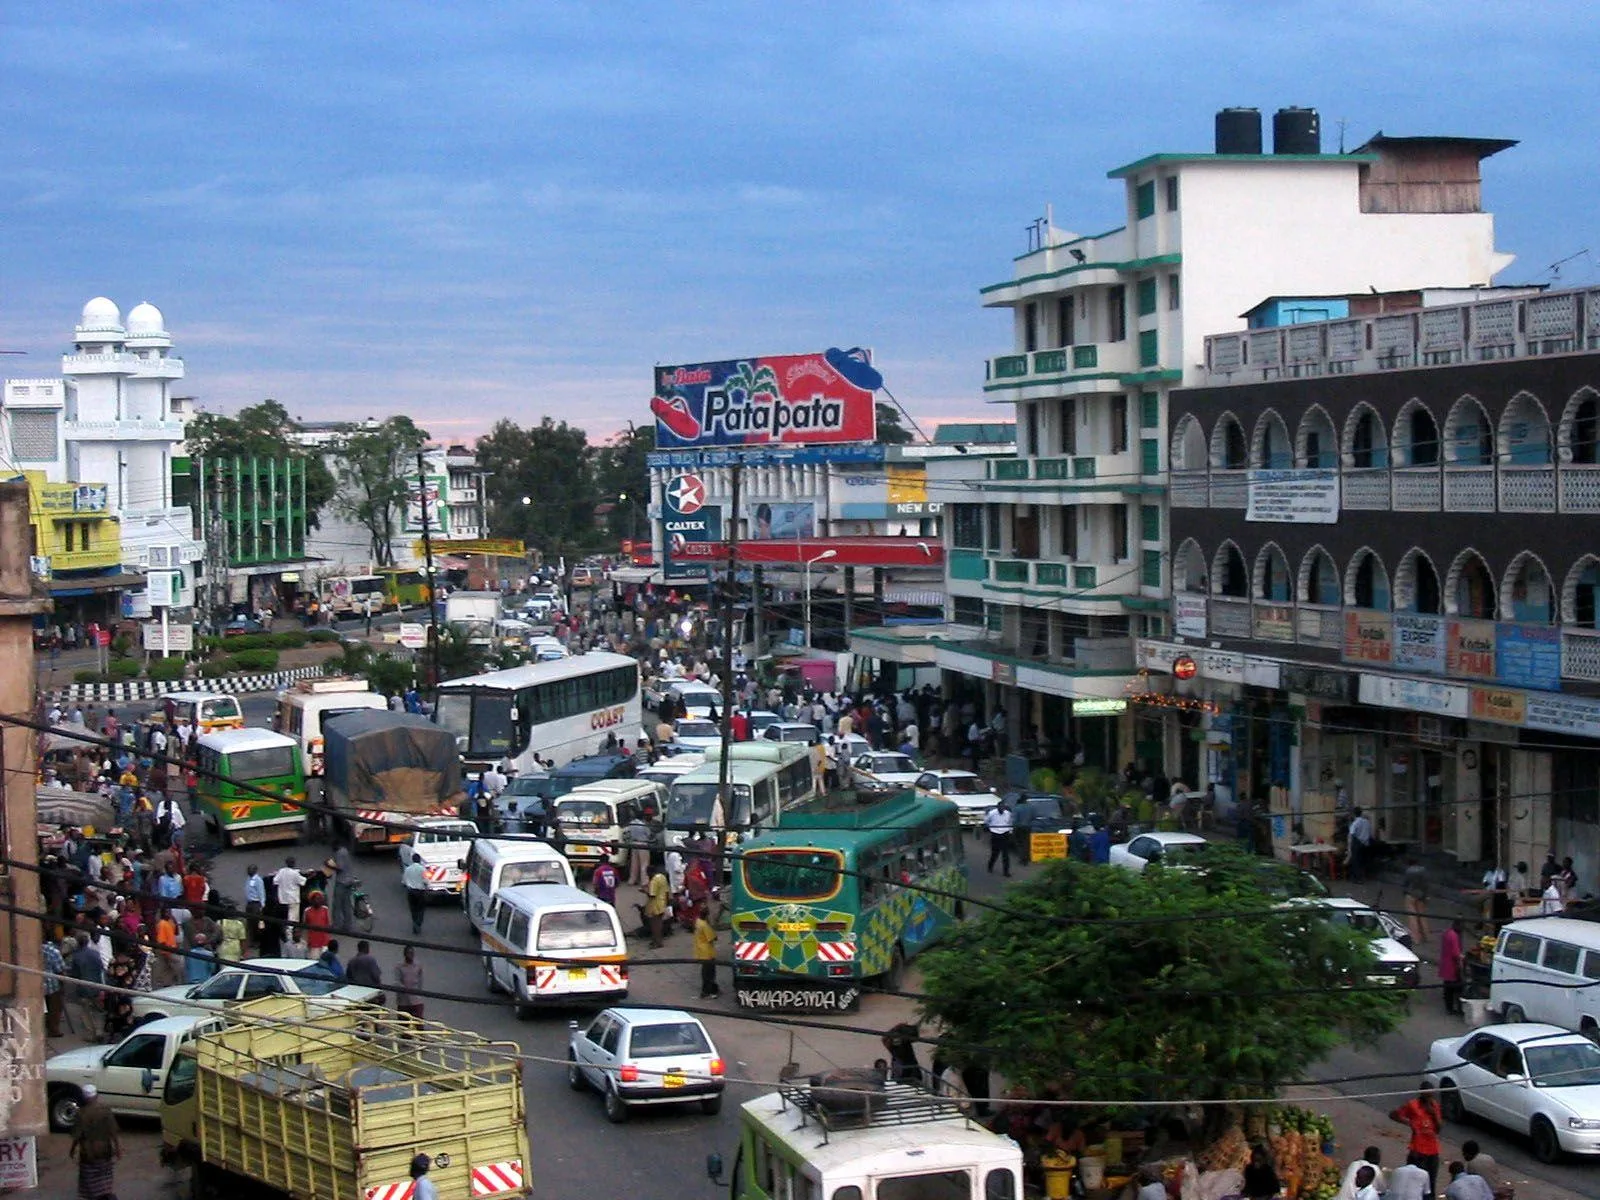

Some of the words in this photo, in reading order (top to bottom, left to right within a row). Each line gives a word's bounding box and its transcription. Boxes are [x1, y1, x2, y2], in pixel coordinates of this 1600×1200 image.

[897, 503, 922, 514] NEW
[665, 520, 706, 531] CALTEX
[591, 706, 626, 730] COAST
